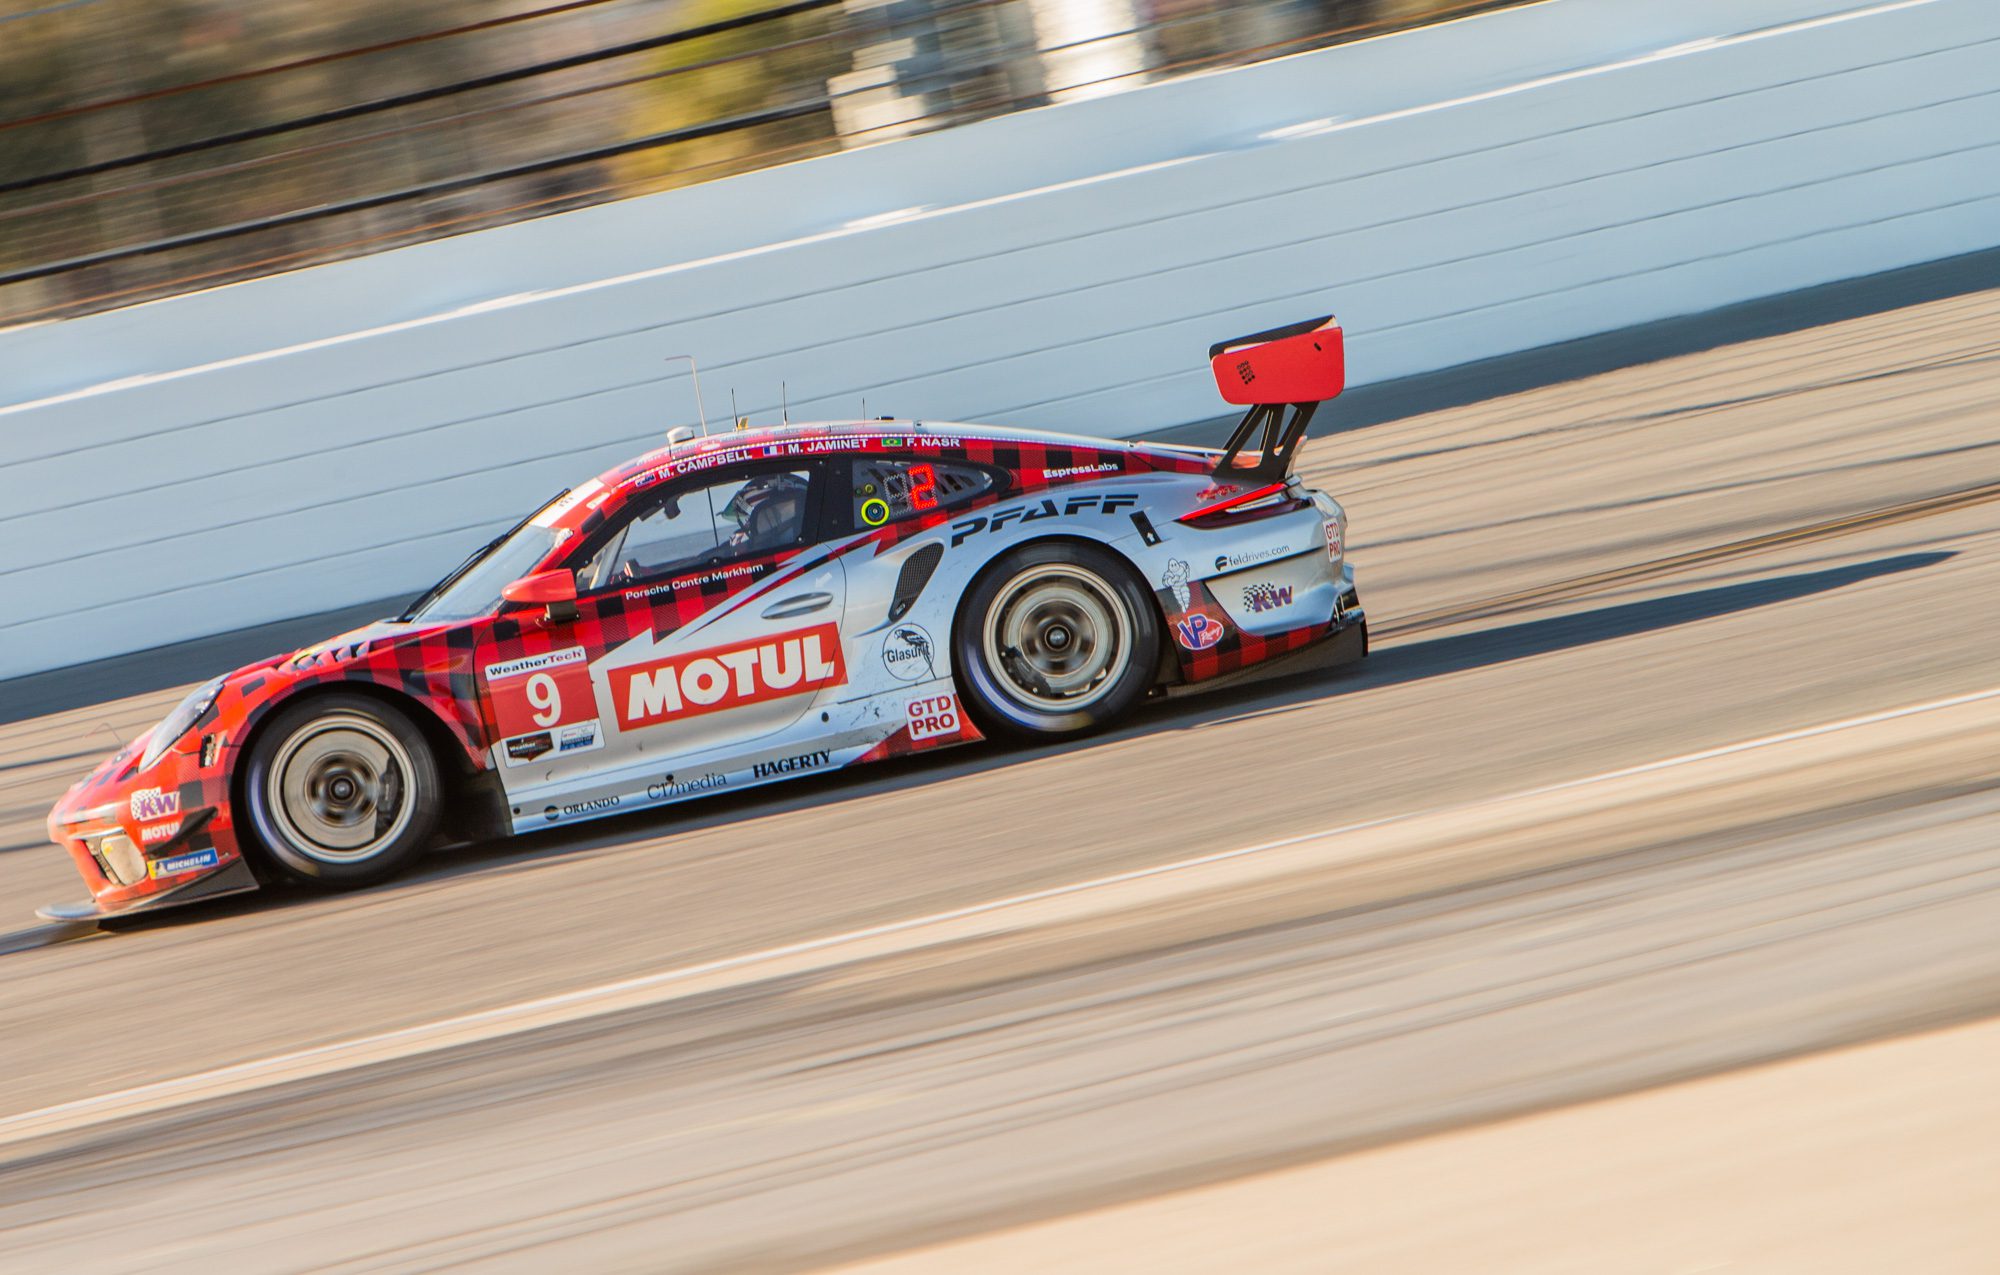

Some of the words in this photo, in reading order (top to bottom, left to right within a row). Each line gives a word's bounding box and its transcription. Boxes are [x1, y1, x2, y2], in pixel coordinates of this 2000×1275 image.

[788, 443, 804, 455] M.
[807, 438, 869, 452] JAMINET
[906, 437, 918, 447] F.
[921, 437, 961, 447] NASR
[658, 468, 674, 480] M.
[676, 449, 753, 474] CAMPBELL
[1042, 461, 1119, 480] EspressLabs
[951, 493, 1139, 549] PFAFF
[1229, 544, 1291, 567] feldrives.com
[625, 584, 670, 601] Porsche
[671, 575, 710, 591] Centre
[711, 563, 765, 582] Markham
[1252, 585, 1293, 613] KW
[1178, 614, 1208, 649] VP
[489, 649, 583, 676] WeatherTech
[627, 634, 835, 721] MOTUL
[526, 672, 562, 728] 9
[908, 695, 952, 718] GTD
[911, 713, 956, 736] PRO
[752, 748, 832, 779] HAGERTY
[140, 793, 177, 818] KW
[563, 795, 621, 816] ORLANDO
[166, 853, 212, 871] MICHELIN
